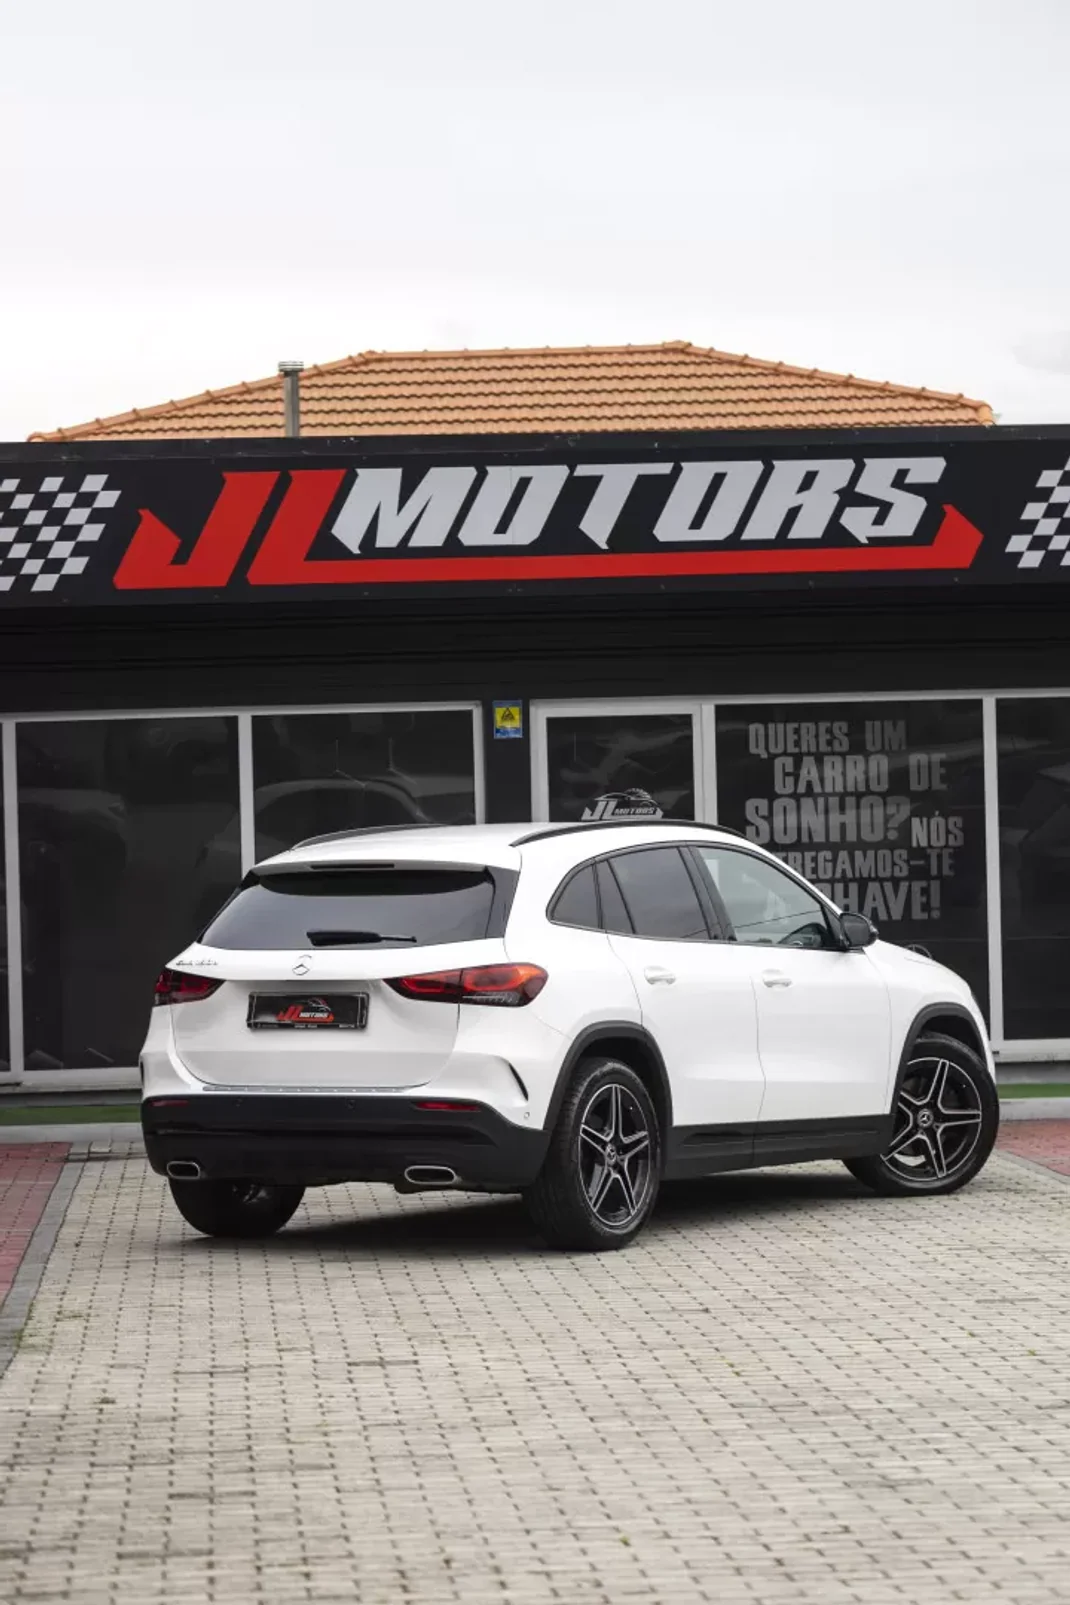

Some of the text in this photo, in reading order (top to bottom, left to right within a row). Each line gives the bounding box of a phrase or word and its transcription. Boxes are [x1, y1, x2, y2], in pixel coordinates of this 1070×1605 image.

[330, 456, 946, 554] MOTORS
[748, 720, 906, 759] QUERES UM
[774, 753, 948, 794] CARRO DE
[745, 795, 964, 847] SONHO? NÓS
